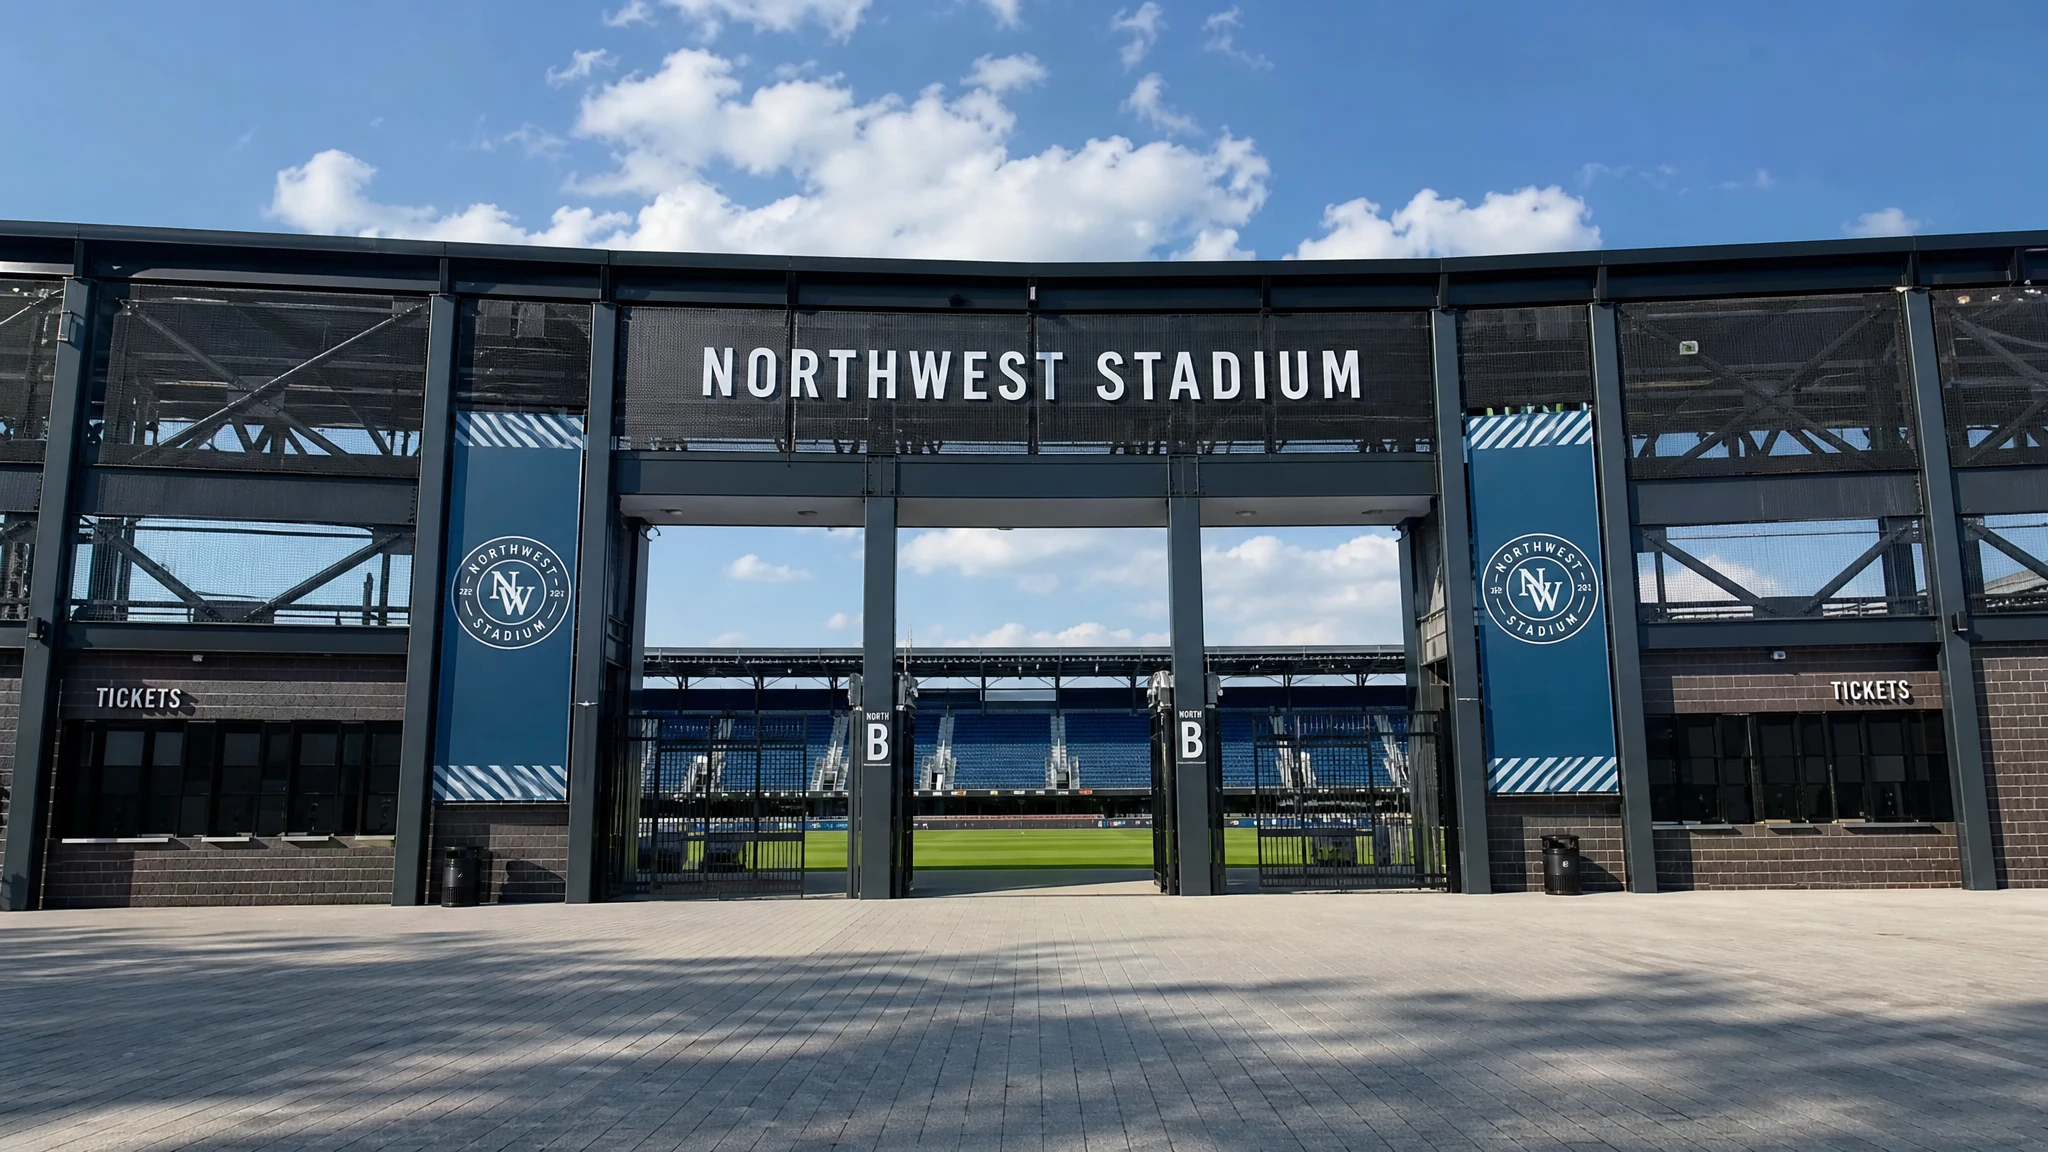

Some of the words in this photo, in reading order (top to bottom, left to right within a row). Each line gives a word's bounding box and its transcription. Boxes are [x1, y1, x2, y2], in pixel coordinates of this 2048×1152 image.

[702, 346, 1064, 401] NORTHWEST
[1096, 350, 1361, 401] STADIUM
[468, 543, 558, 574] NORTHWEST
[1495, 541, 1582, 573] NORTHWEST
[473, 618, 546, 641] STADIUM
[1506, 613, 1578, 637] STADIUM
[96, 687, 181, 709] TICKETS
[1830, 680, 1910, 700] TICKETS
[866, 712, 890, 721] NORTH
[1178, 710, 1203, 719] NORTH
[867, 723, 889, 761] B
[1181, 721, 1204, 759] B
